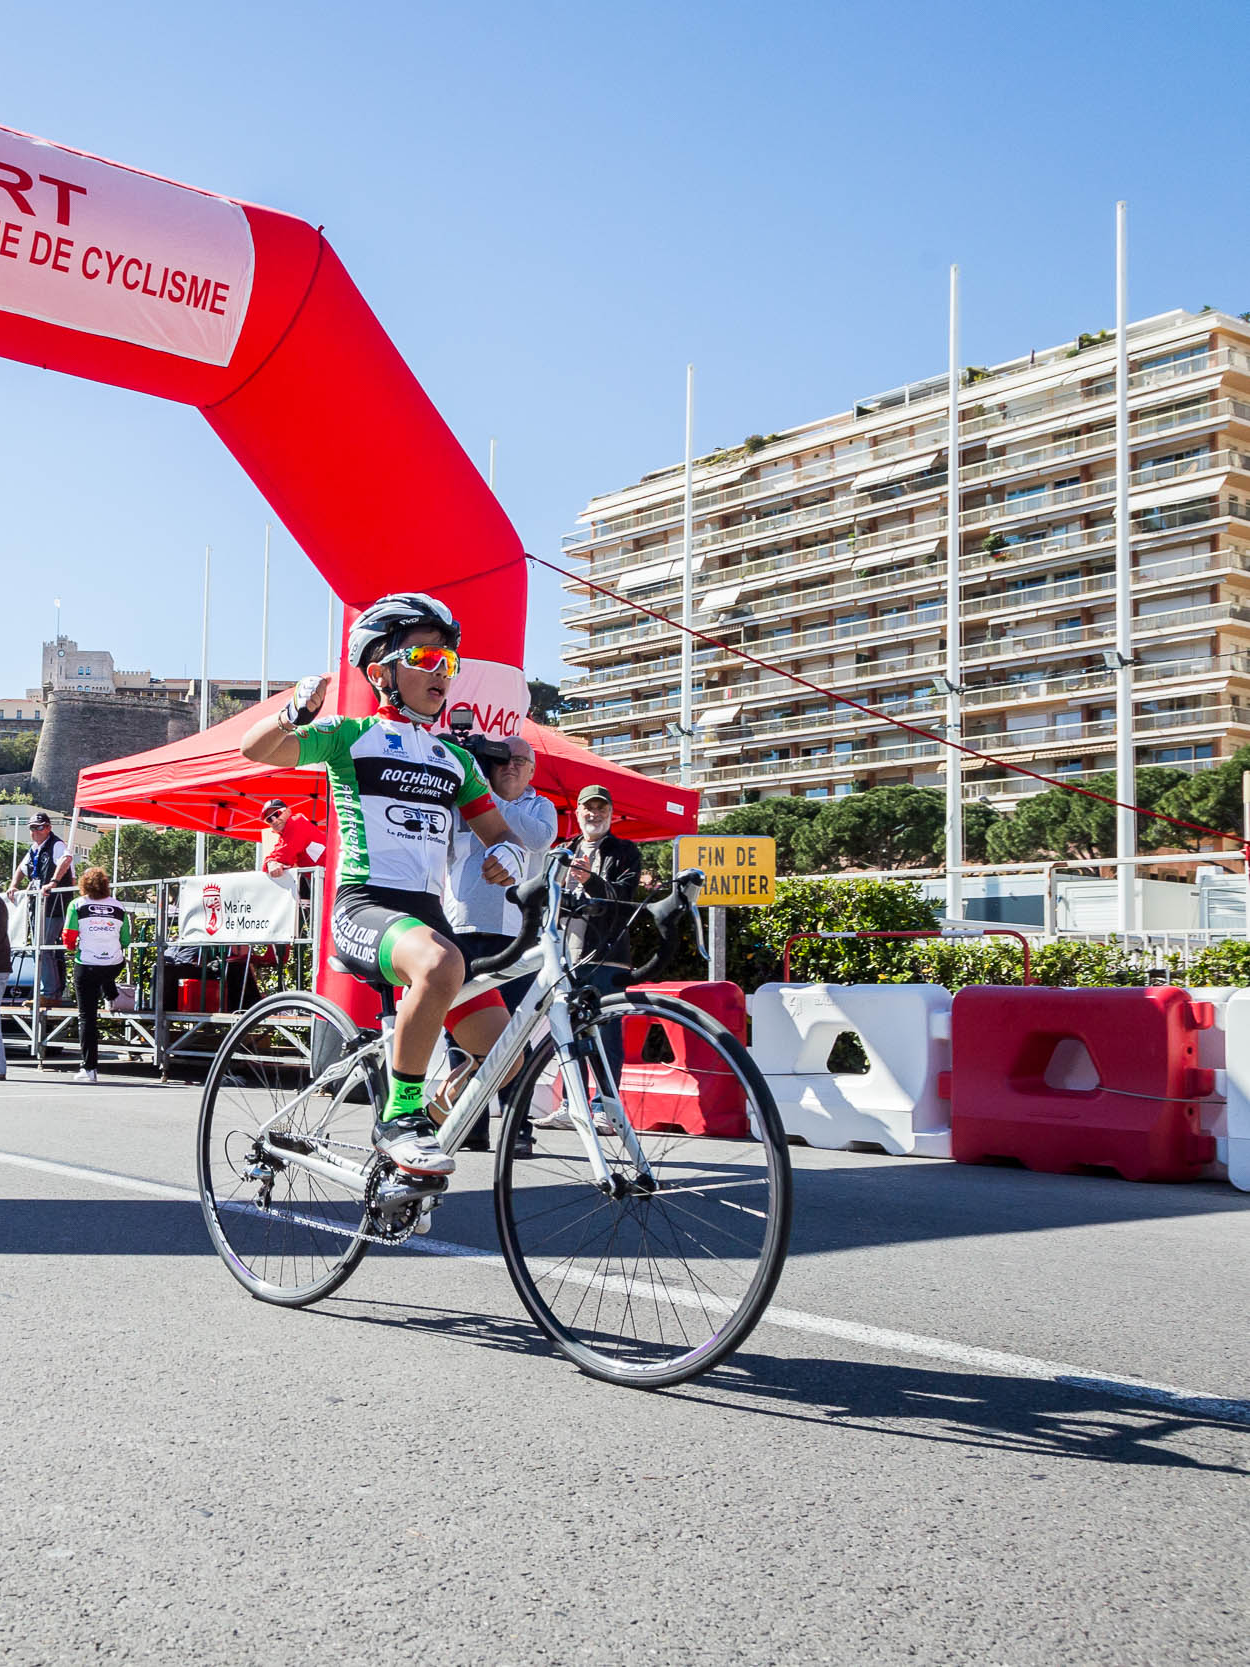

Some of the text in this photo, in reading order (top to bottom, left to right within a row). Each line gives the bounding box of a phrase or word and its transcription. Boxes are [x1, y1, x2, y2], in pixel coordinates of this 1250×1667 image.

[29, 231, 74, 273] DE
[81, 246, 230, 316] CYCLISME
[380, 768, 456, 794] ROCHEVILLE
[399, 785, 442, 798] LE CANNET
[697, 846, 757, 867] FIN DE
[701, 875, 769, 895] HANTIER
[224, 900, 252, 914] Mairie
[225, 917, 269, 930] de Monaco
